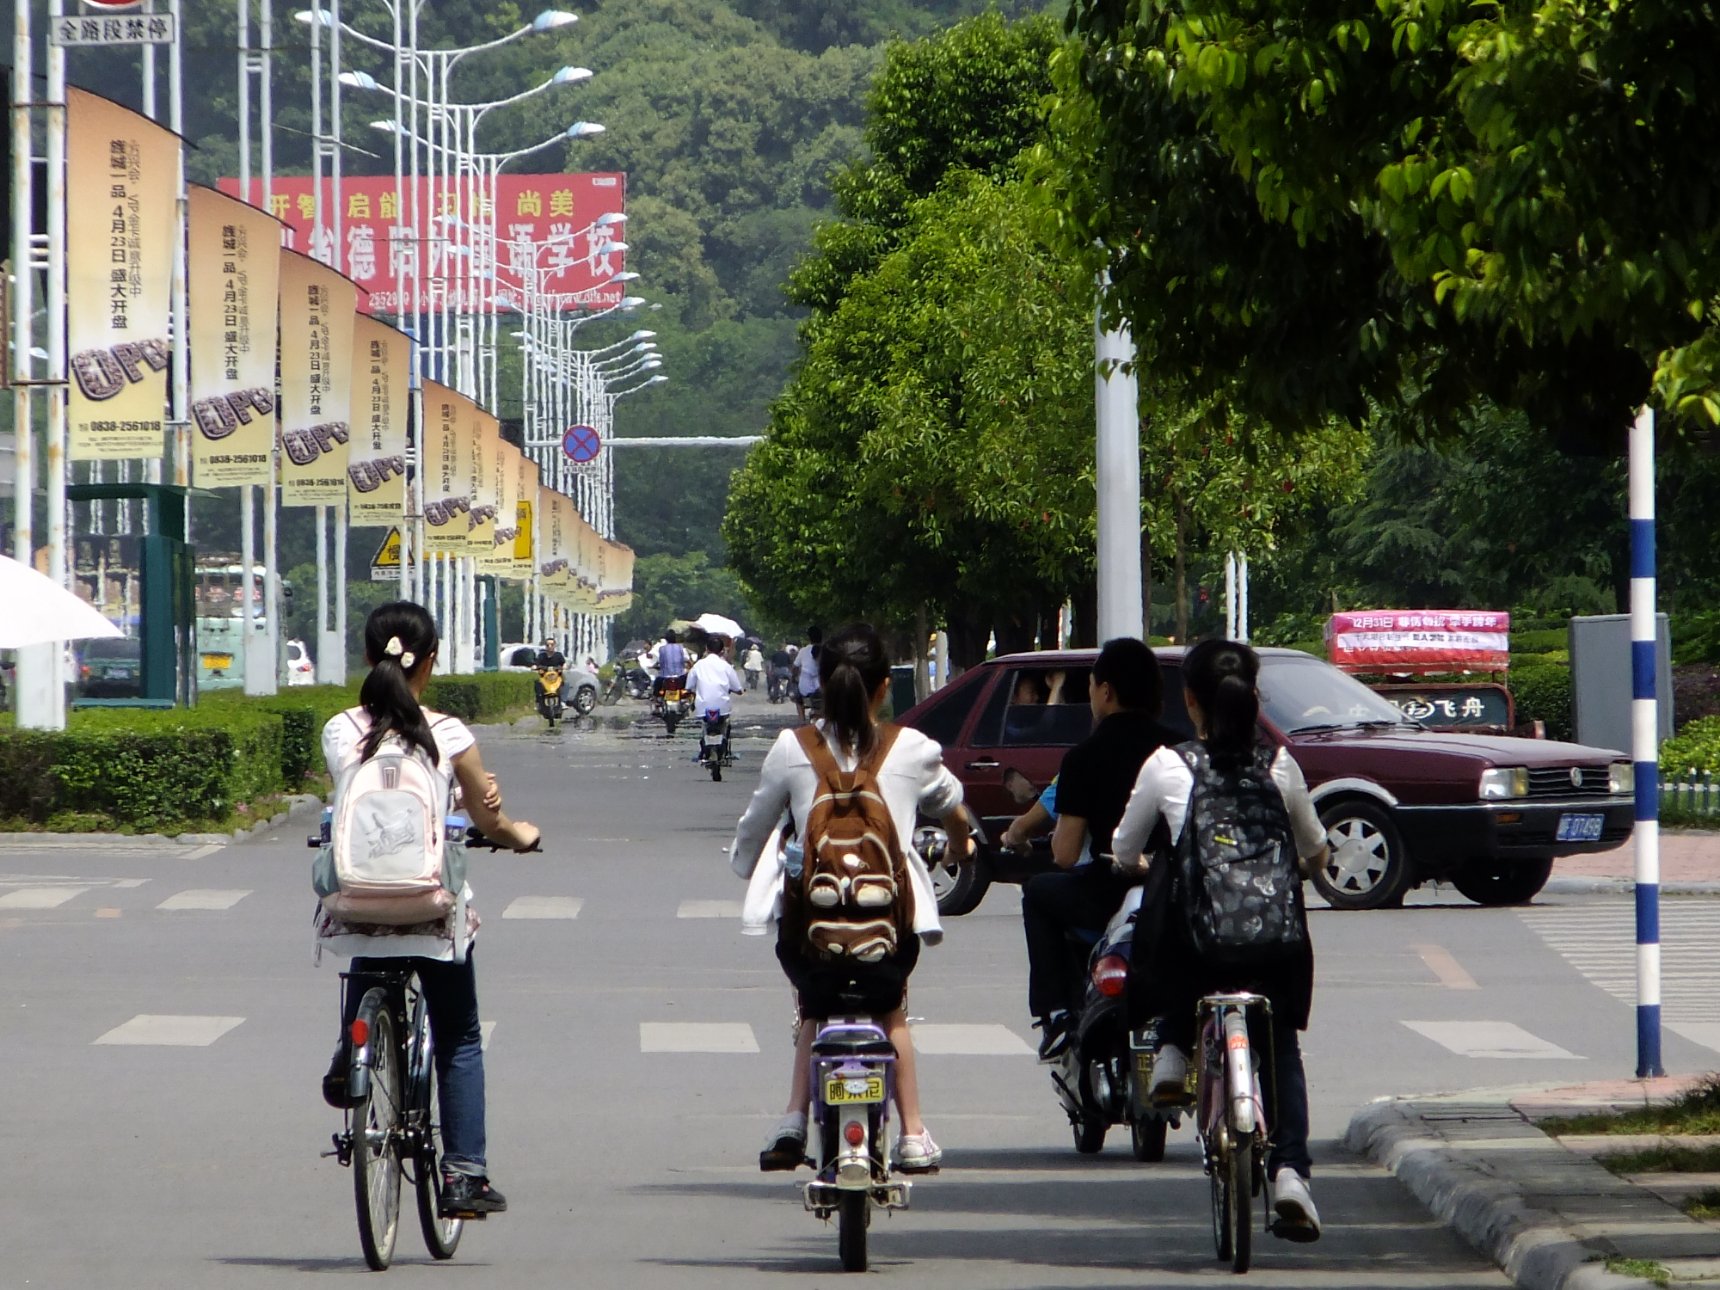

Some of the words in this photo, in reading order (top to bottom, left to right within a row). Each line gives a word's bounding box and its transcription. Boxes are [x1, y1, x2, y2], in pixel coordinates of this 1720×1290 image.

[59, 17, 168, 41] 全路段禁停
[517, 188, 575, 217] 尚美
[110, 268, 128, 329] 盛大开盘
[1352, 616, 1394, 628] 12月31日
[1434, 696, 1485, 718] 飞舟
